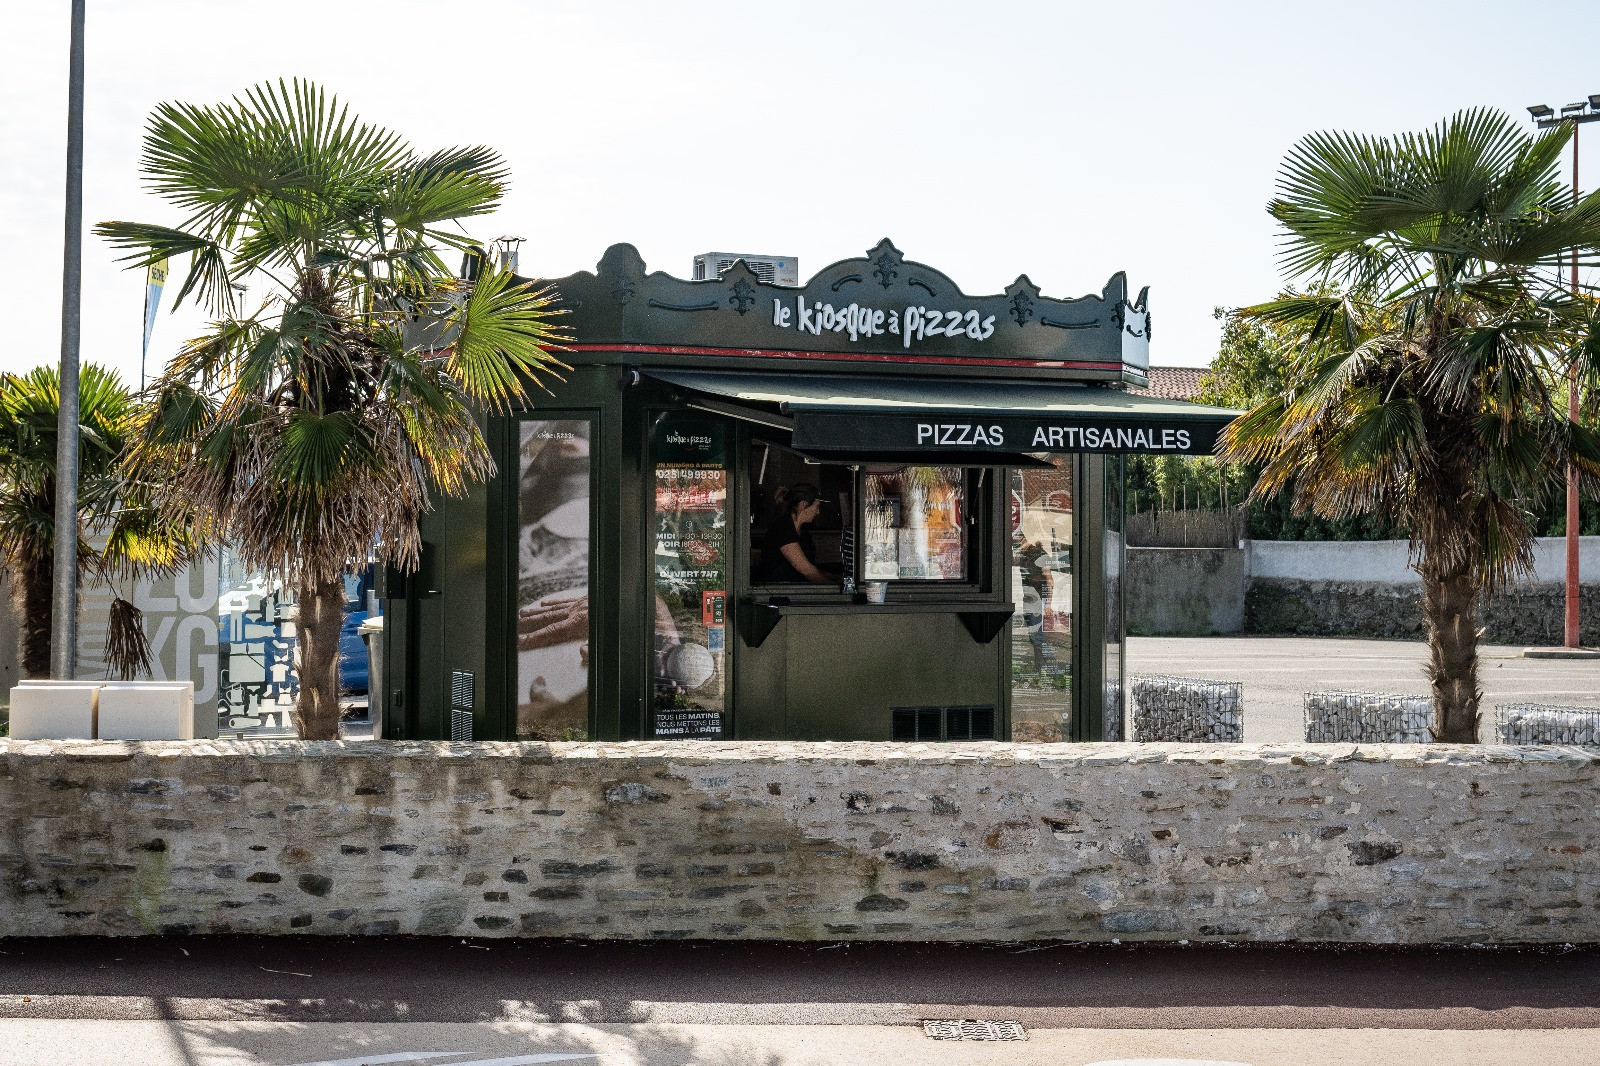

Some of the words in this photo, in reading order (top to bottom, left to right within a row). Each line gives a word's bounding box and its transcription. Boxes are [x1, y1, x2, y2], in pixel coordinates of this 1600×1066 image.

[773, 298, 791, 328] le
[797, 295, 885, 341] kiosque
[887, 309, 900, 334] à
[903, 306, 996, 348] pizzas
[917, 423, 1004, 446] PIZZAS
[1031, 426, 1191, 450] ARTISANALES
[655, 727, 684, 735] MAINS
